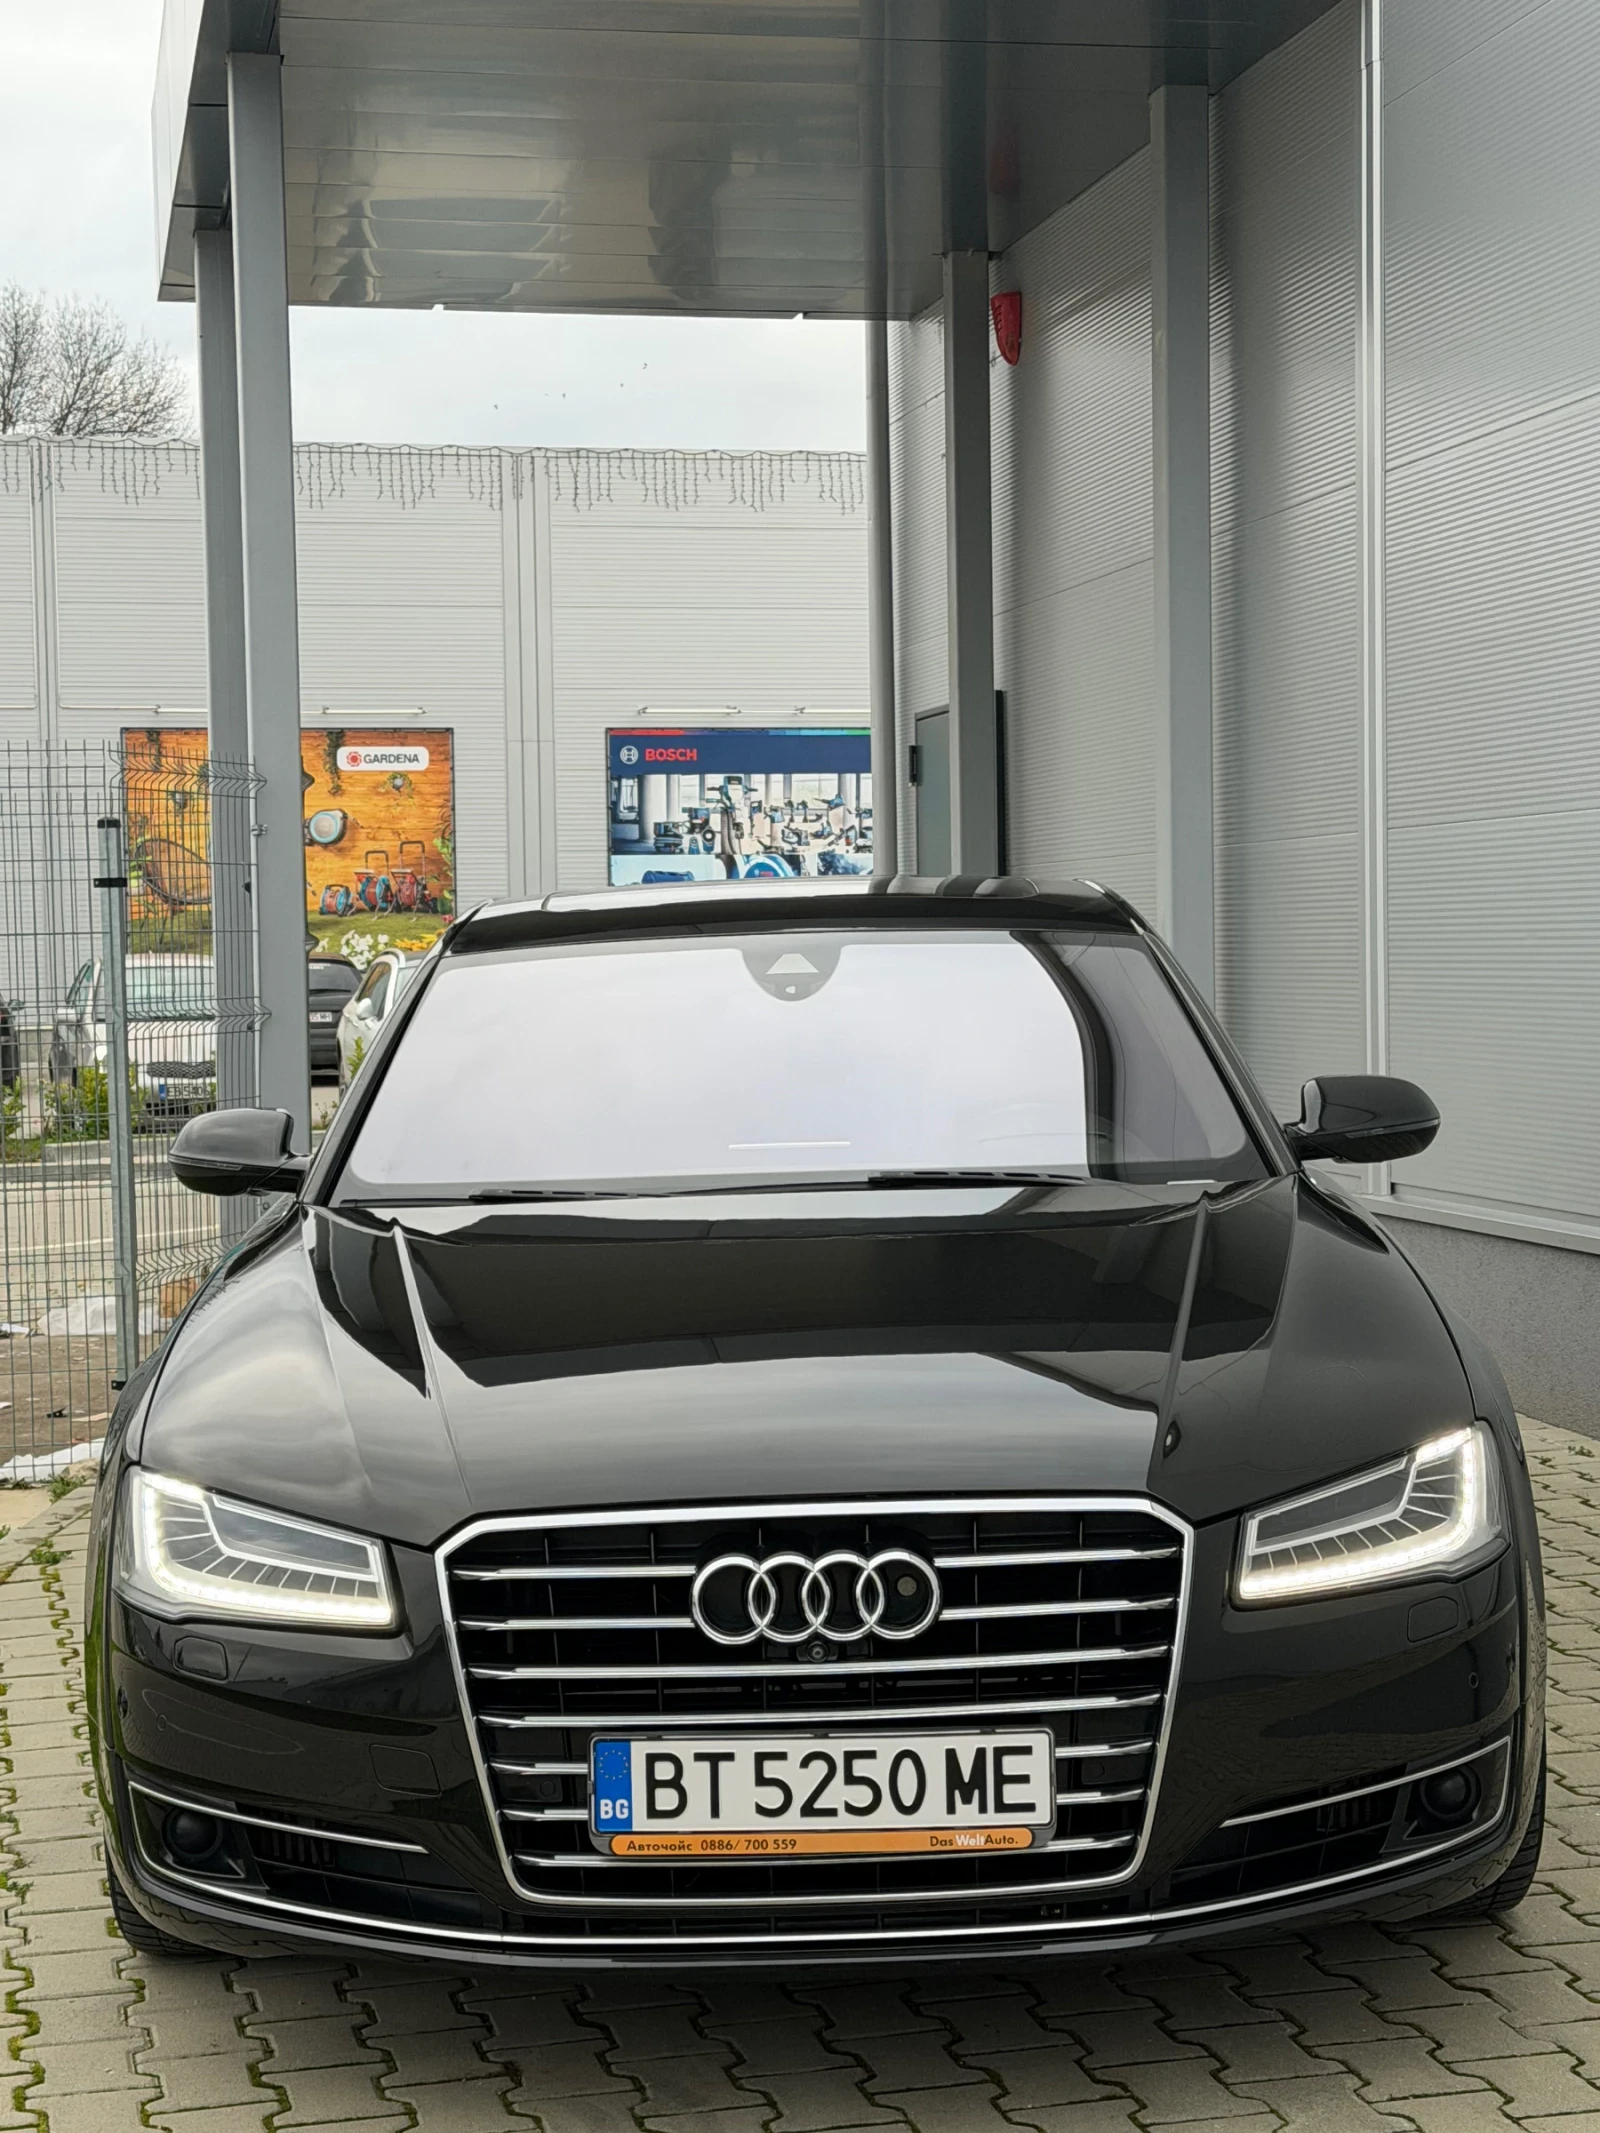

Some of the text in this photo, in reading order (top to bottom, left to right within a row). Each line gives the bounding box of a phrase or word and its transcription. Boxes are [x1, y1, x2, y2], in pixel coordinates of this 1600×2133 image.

[363, 753, 420, 764] GARDENA
[645, 748, 698, 761] BOSCH
[645, 1745, 1037, 1820] BT 5250 ME
[600, 1798, 629, 1820] BG
[626, 1838, 797, 1852] Авточойс 0886/ 700 559
[929, 1835, 954, 1847] Das
